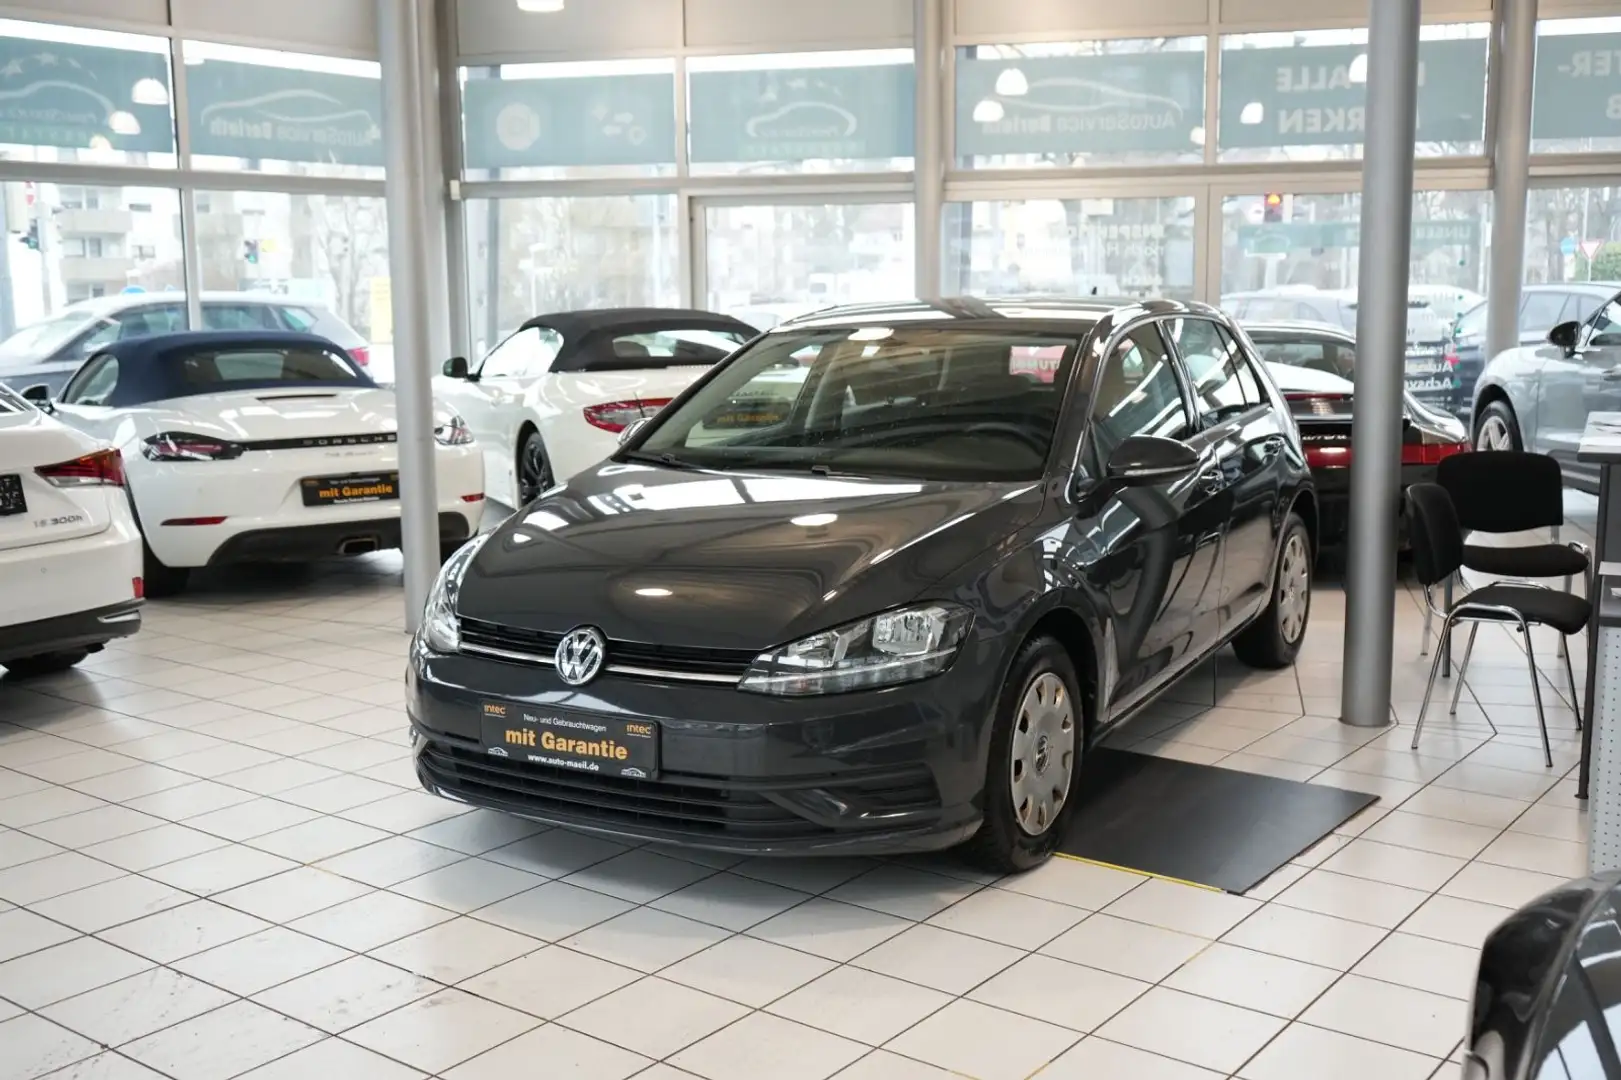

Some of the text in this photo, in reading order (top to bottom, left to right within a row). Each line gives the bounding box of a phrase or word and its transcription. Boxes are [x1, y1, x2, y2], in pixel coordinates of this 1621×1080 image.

[319, 484, 393, 498] mit Garantie
[50, 514, 83, 525] 300h
[523, 713, 607, 733] Neu- und Gebrauchtwagen
[504, 728, 628, 760] mit Garantie
